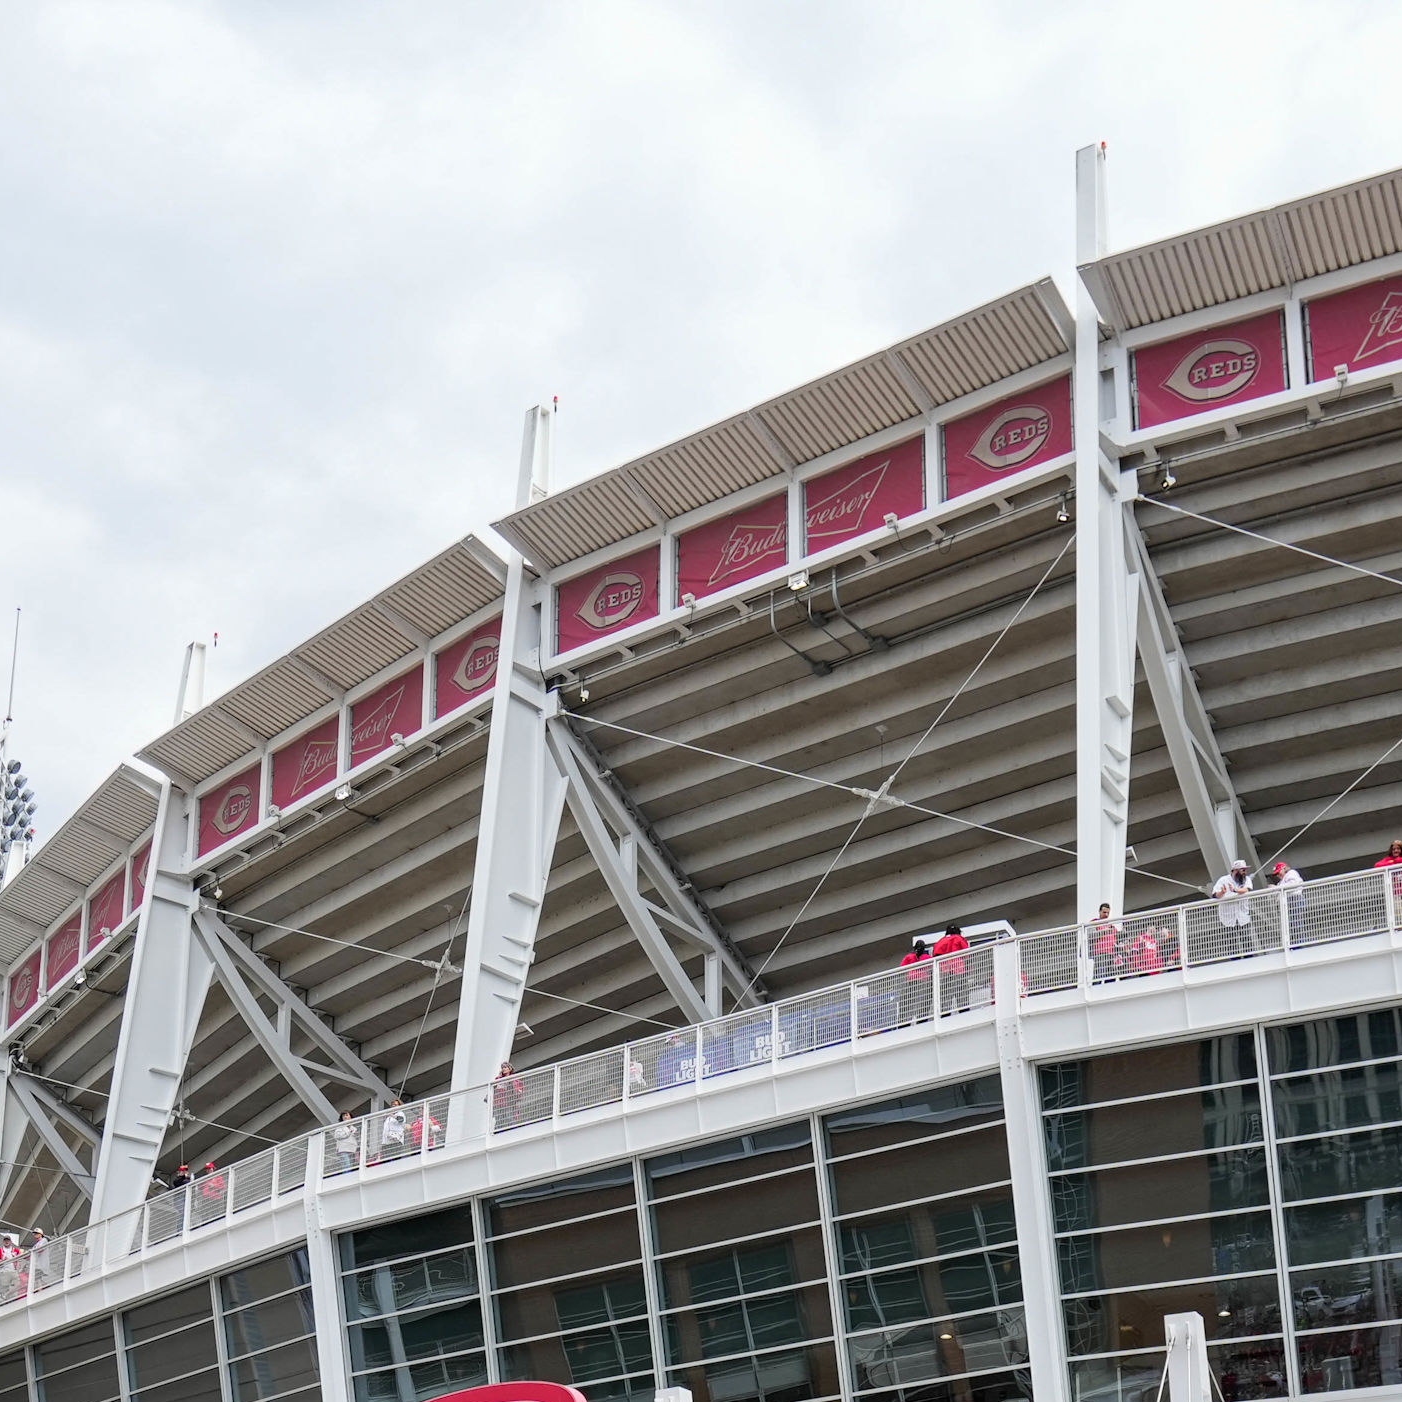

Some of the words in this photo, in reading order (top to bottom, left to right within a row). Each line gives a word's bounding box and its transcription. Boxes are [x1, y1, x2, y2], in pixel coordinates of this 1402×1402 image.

[1191, 353, 1257, 384] REDS
[992, 416, 1051, 452] REDS
[597, 584, 644, 614] REDS
